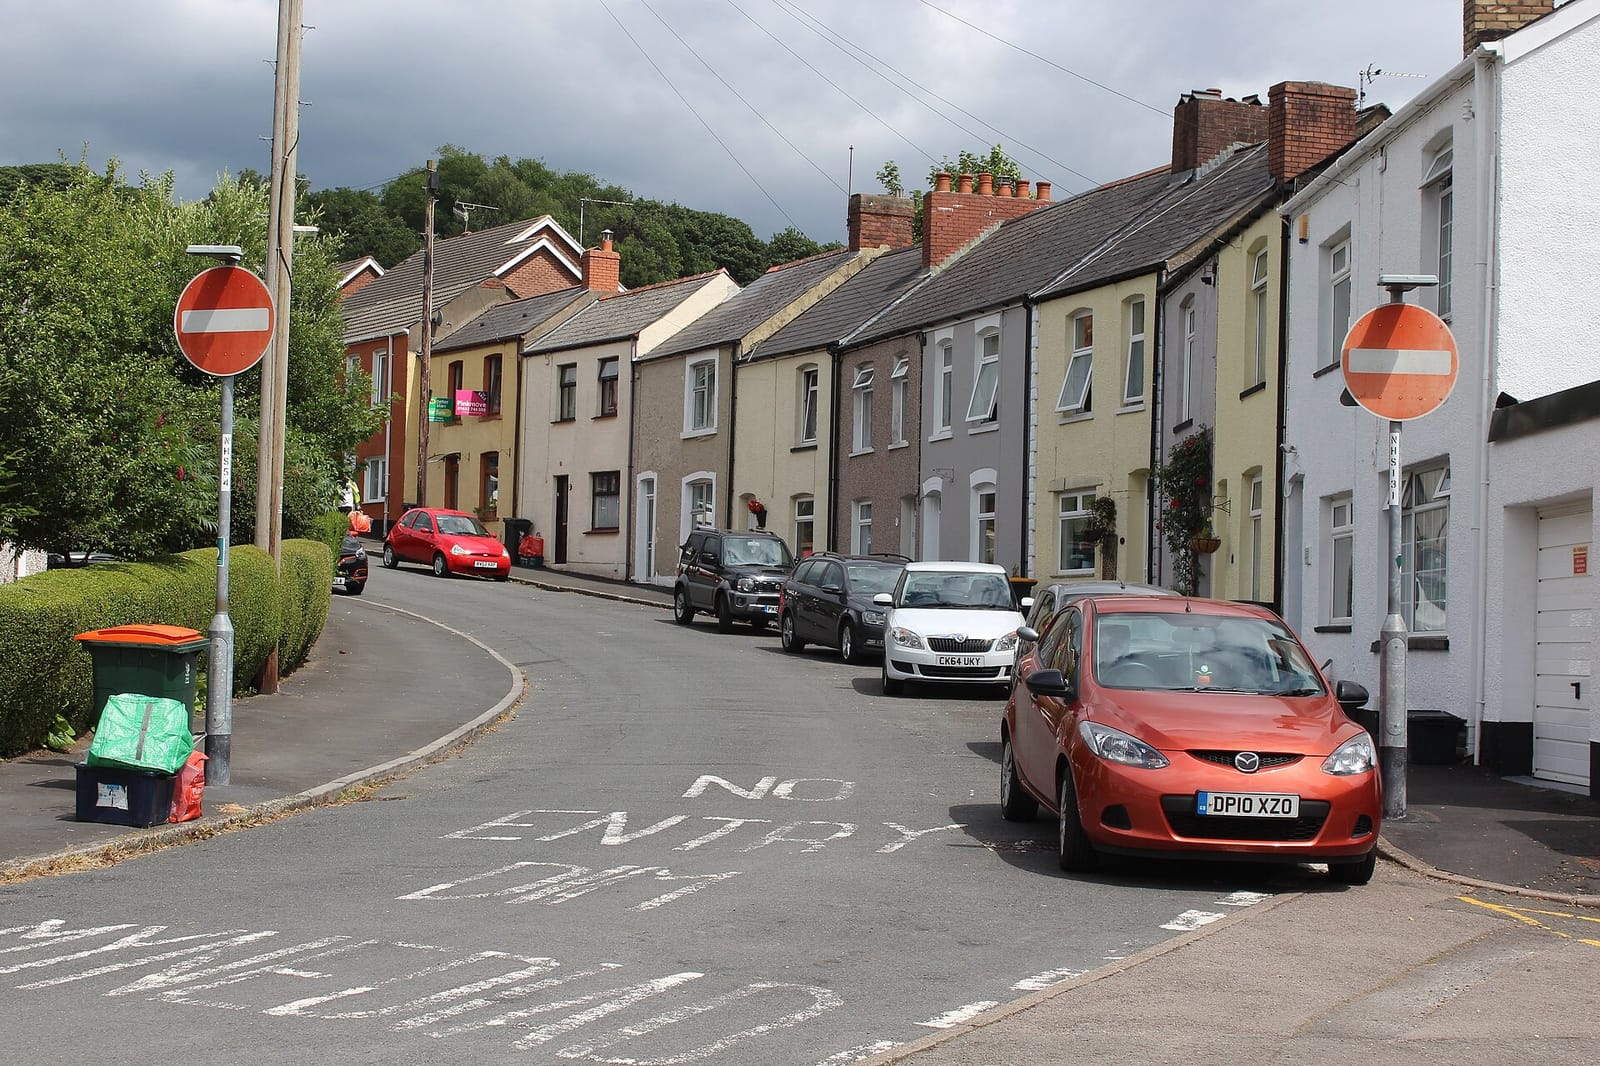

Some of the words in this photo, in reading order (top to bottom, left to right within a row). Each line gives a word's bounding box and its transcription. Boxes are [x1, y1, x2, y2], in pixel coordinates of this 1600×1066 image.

[963, 656, 981, 666] UKY
[682, 774, 856, 801] NO
[1213, 796, 1253, 814] DP10
[1258, 797, 1292, 815] XZO
[438, 809, 968, 854] ENTRY
[394, 860, 744, 913] DIM
